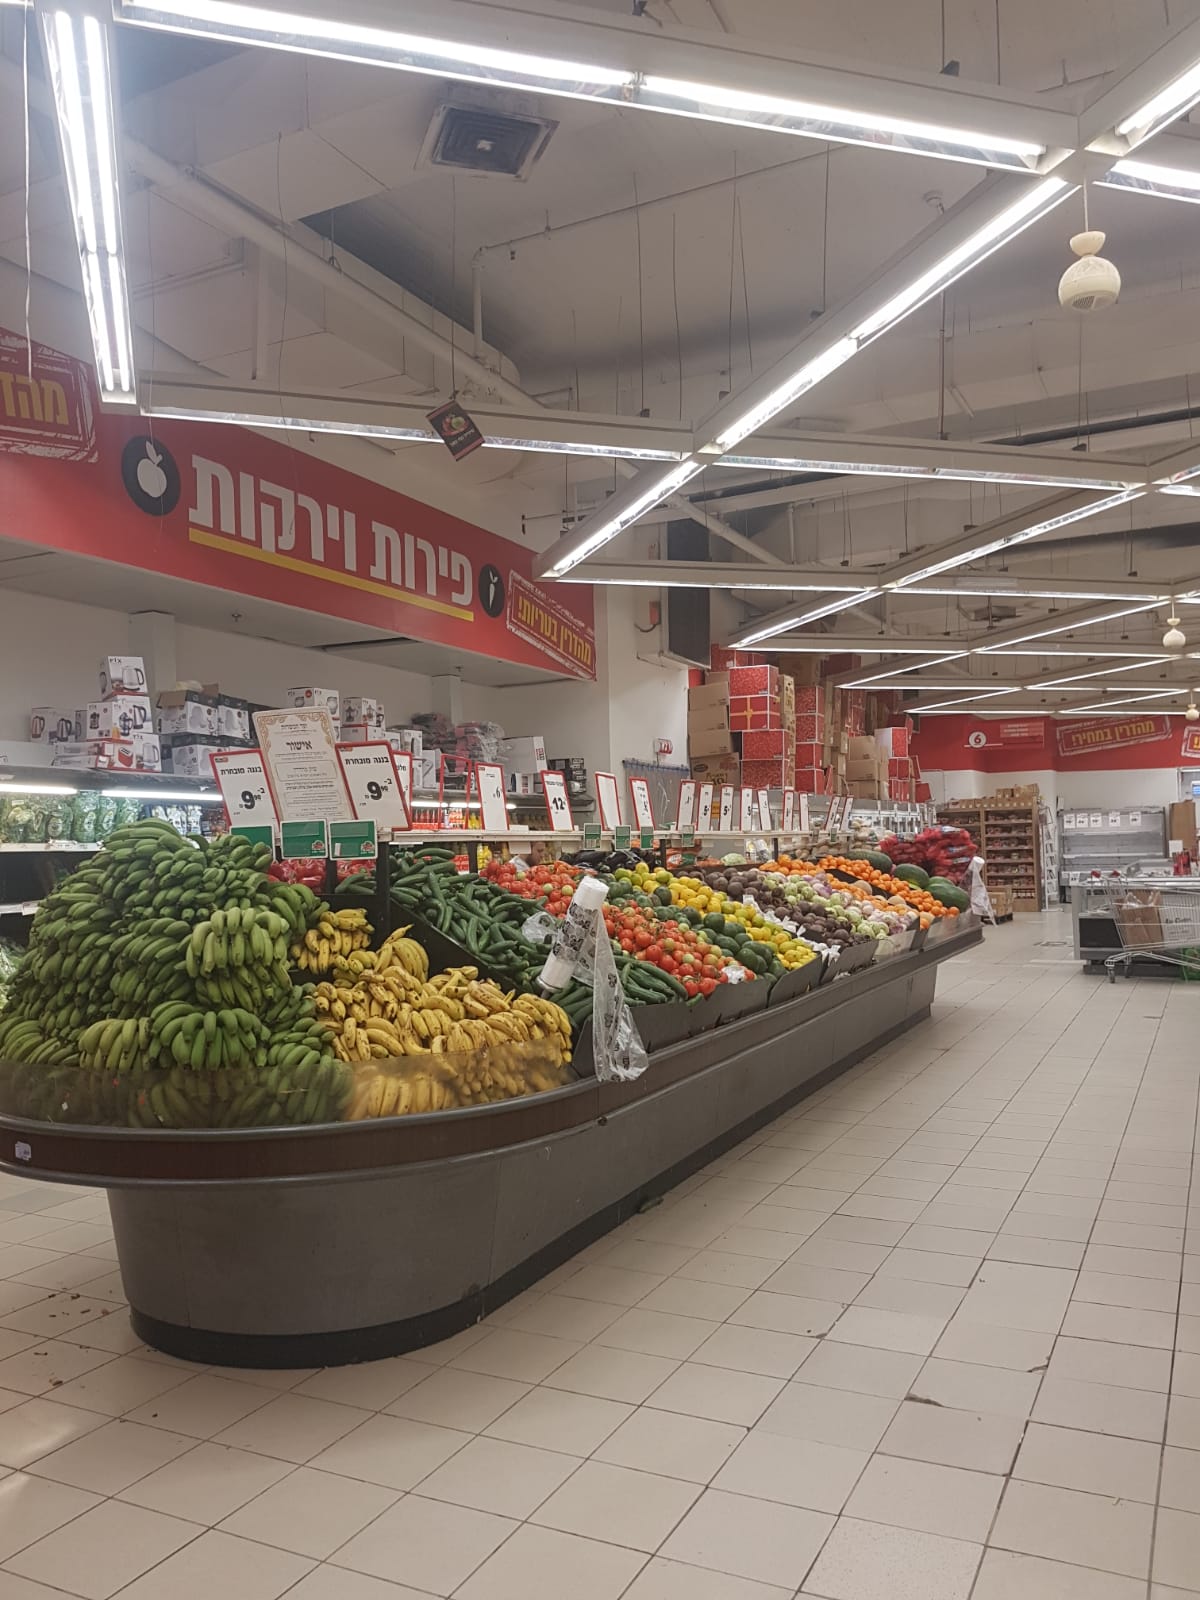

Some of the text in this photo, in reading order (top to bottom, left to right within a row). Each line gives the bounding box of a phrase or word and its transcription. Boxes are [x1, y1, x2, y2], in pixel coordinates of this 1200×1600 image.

[188, 454, 473, 606] פירות וירקות
[559, 625, 592, 666] מהדרין
[1114, 719, 1156, 742] מהדרין
[285, 740, 313, 751] אישור
[344, 756, 390, 765] בננה מובחרת
[220, 766, 262, 775] בננה מובחרת
